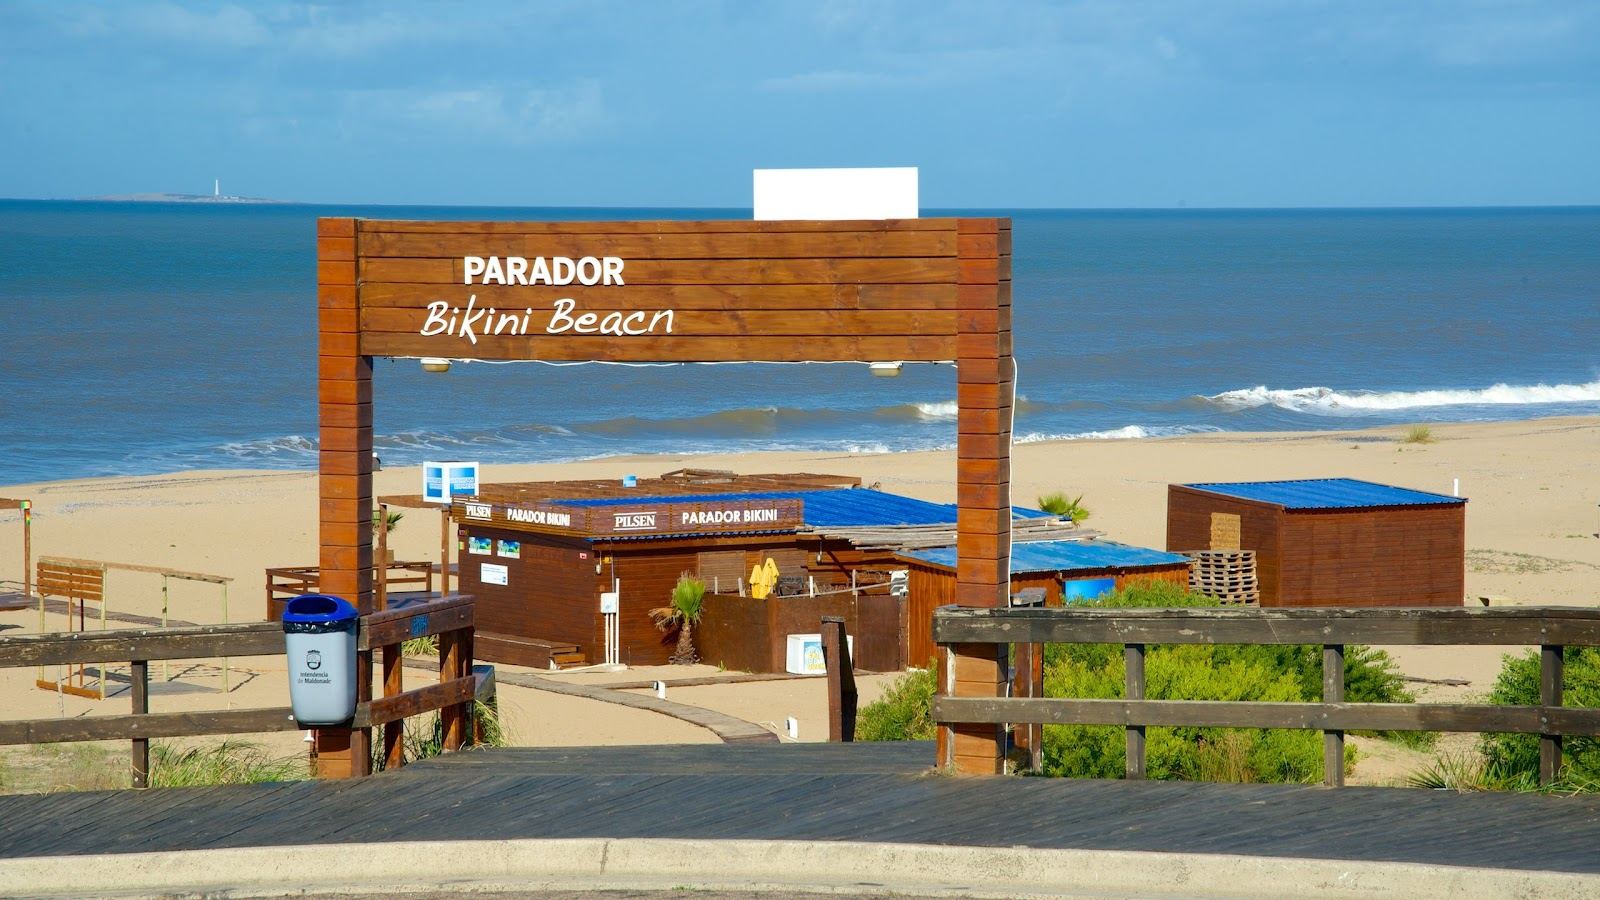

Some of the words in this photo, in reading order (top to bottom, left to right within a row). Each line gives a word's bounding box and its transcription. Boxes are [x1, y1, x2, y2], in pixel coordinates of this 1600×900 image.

[463, 256, 625, 286] PARADOR
[420, 294, 533, 345] Bikini
[466, 505, 492, 518] PILSEN
[507, 508, 546, 524] PARADOR
[547, 513, 571, 527] BIKINI
[682, 511, 741, 525] PARADOR
[743, 509, 778, 523] BIKINI
[615, 514, 656, 528] PILSEN
